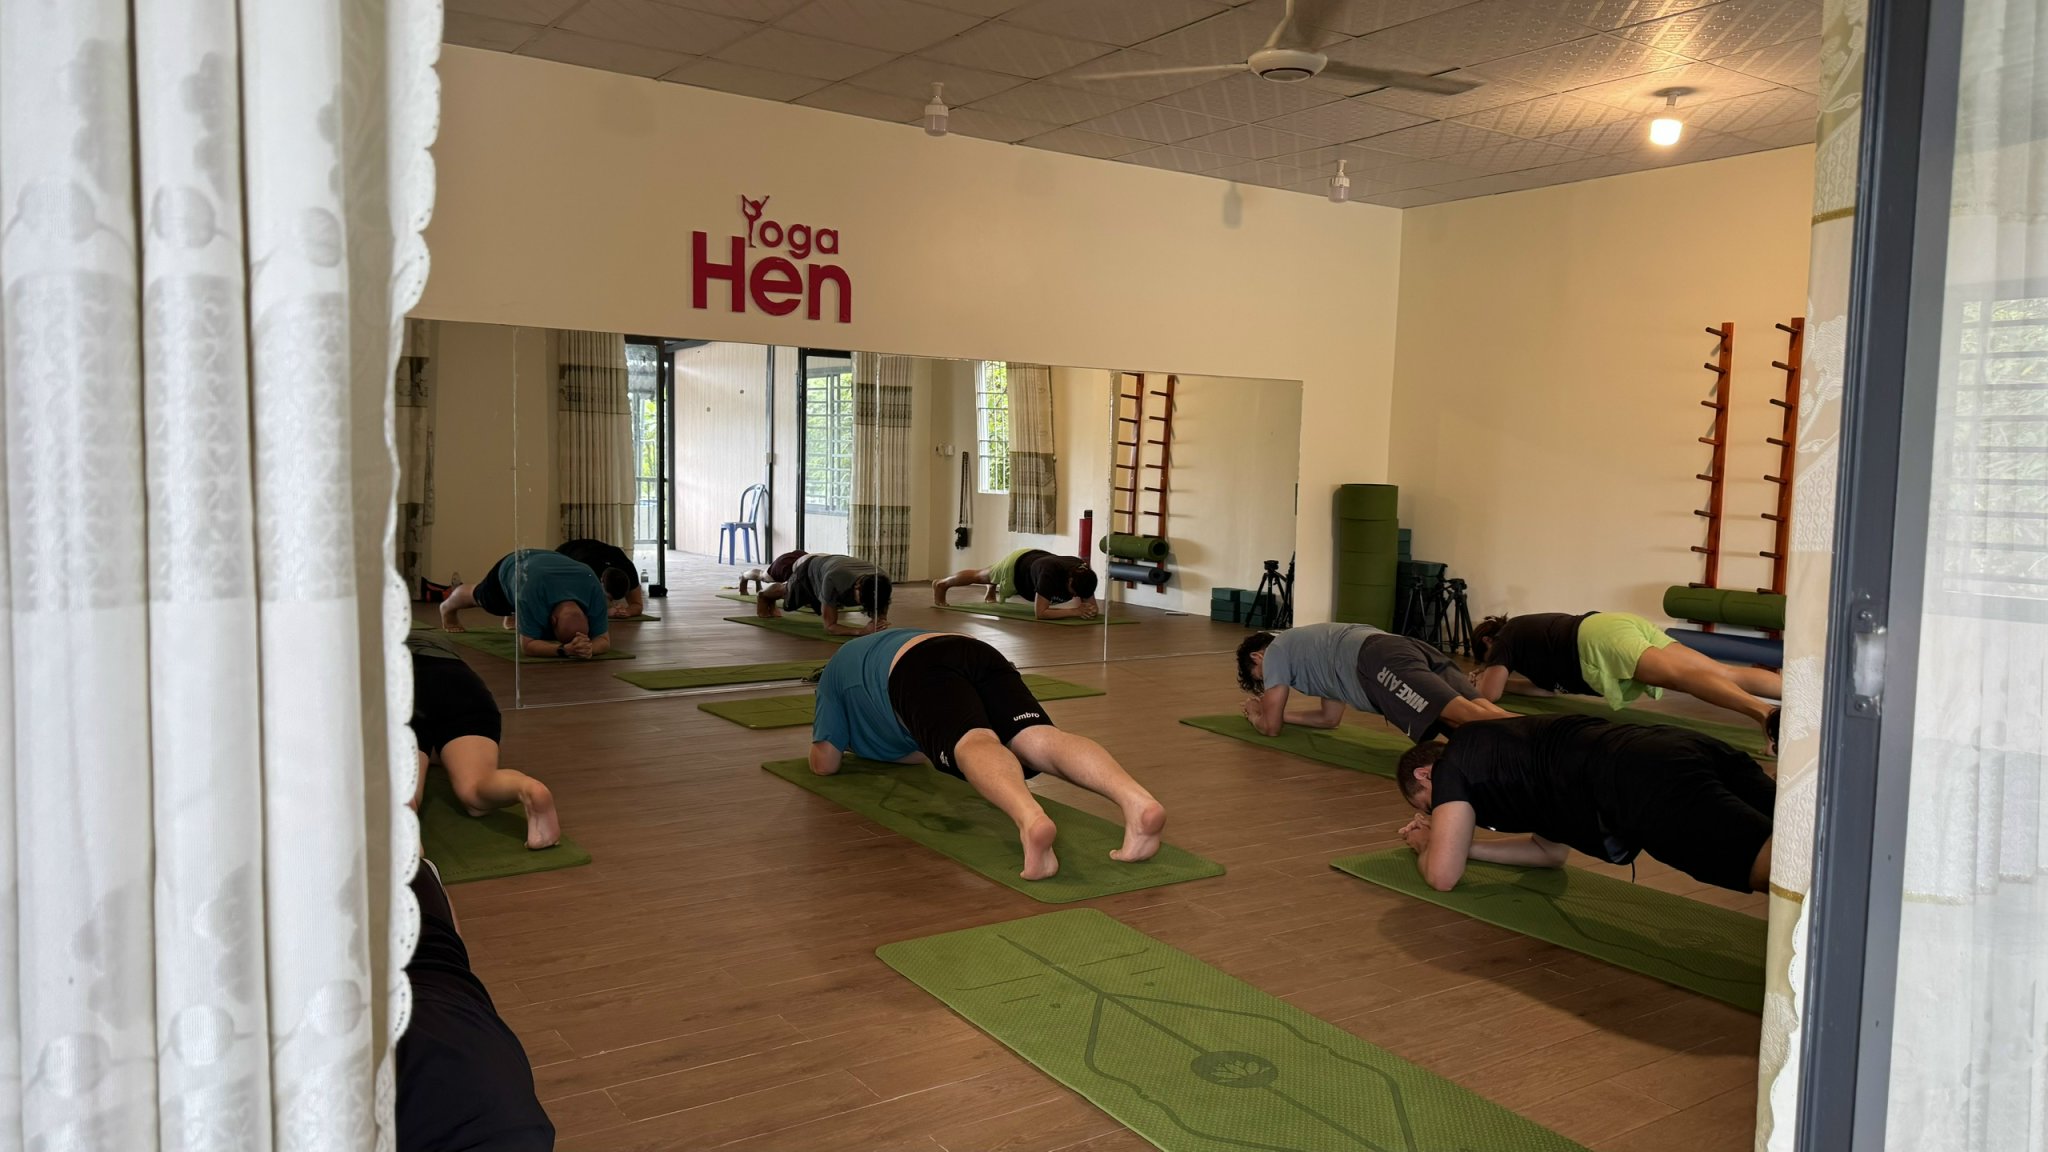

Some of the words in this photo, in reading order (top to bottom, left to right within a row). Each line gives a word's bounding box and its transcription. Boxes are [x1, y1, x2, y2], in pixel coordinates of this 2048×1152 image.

[741, 194, 839, 260] Yoga
[692, 230, 852, 324] Hen
[1376, 666, 1402, 692] AIR
[1395, 683, 1429, 713] NIKE
[1013, 711, 1040, 722] umbro
